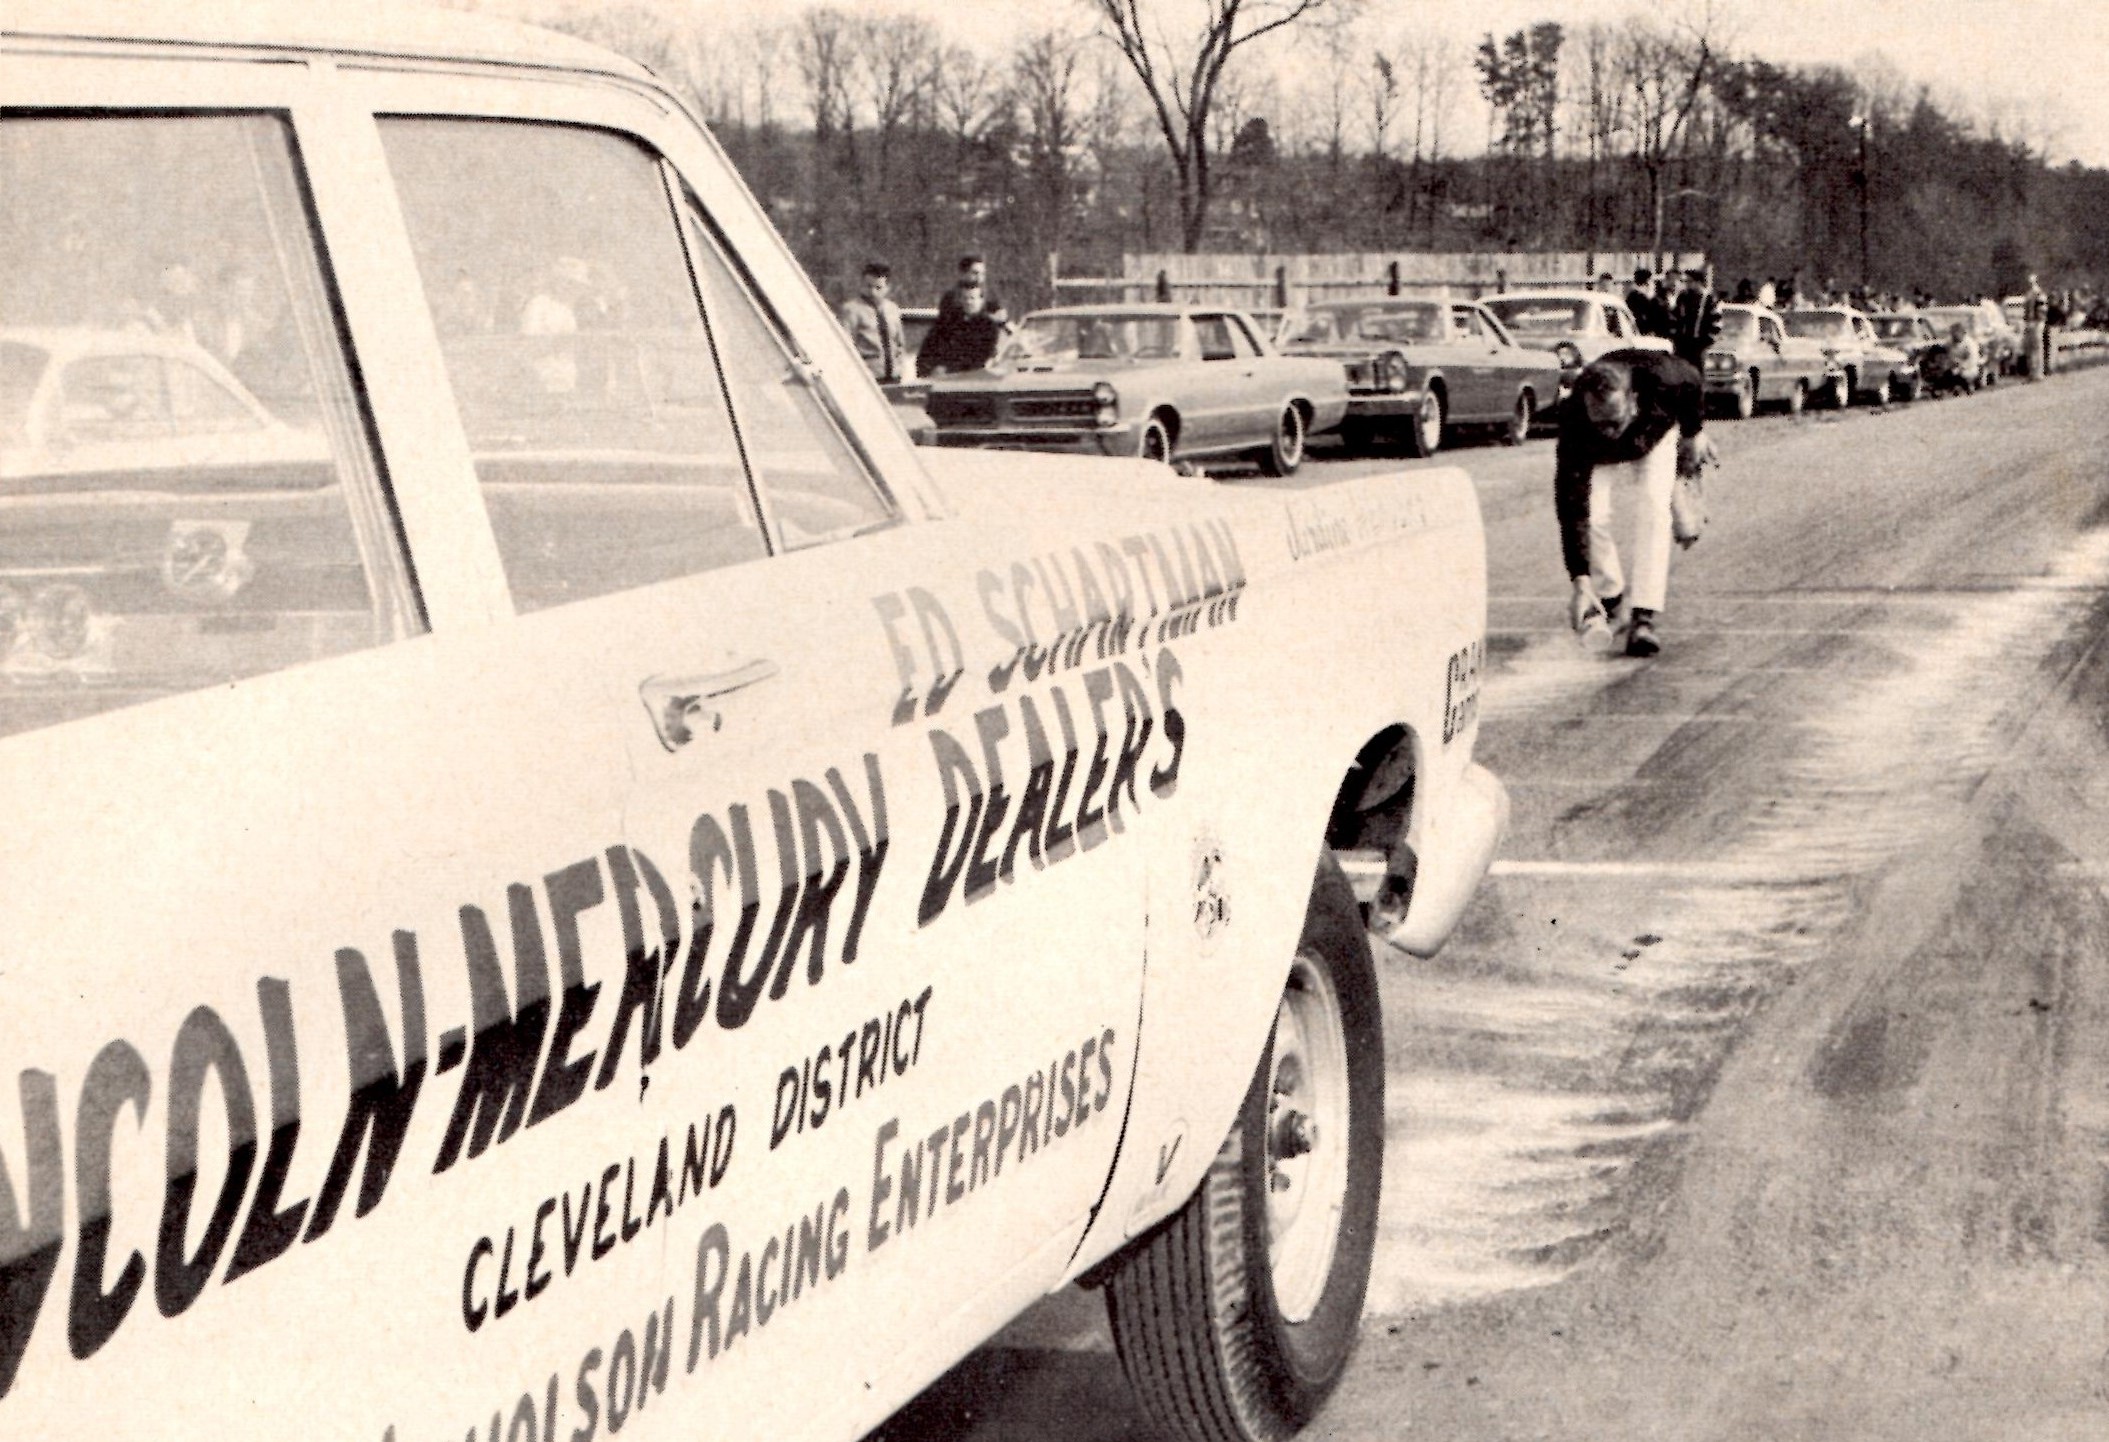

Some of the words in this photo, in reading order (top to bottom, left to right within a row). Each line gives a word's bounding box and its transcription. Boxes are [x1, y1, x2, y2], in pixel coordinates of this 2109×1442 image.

[871, 586, 965, 728] ED
[976, 517, 1247, 694] SCHARTMAN
[462, 1104, 737, 1332] CLEVELAND
[769, 985, 933, 1150] DISTRICT
[686, 1187, 850, 1375] RACING
[866, 1028, 1116, 1252] ENTERPRISES
